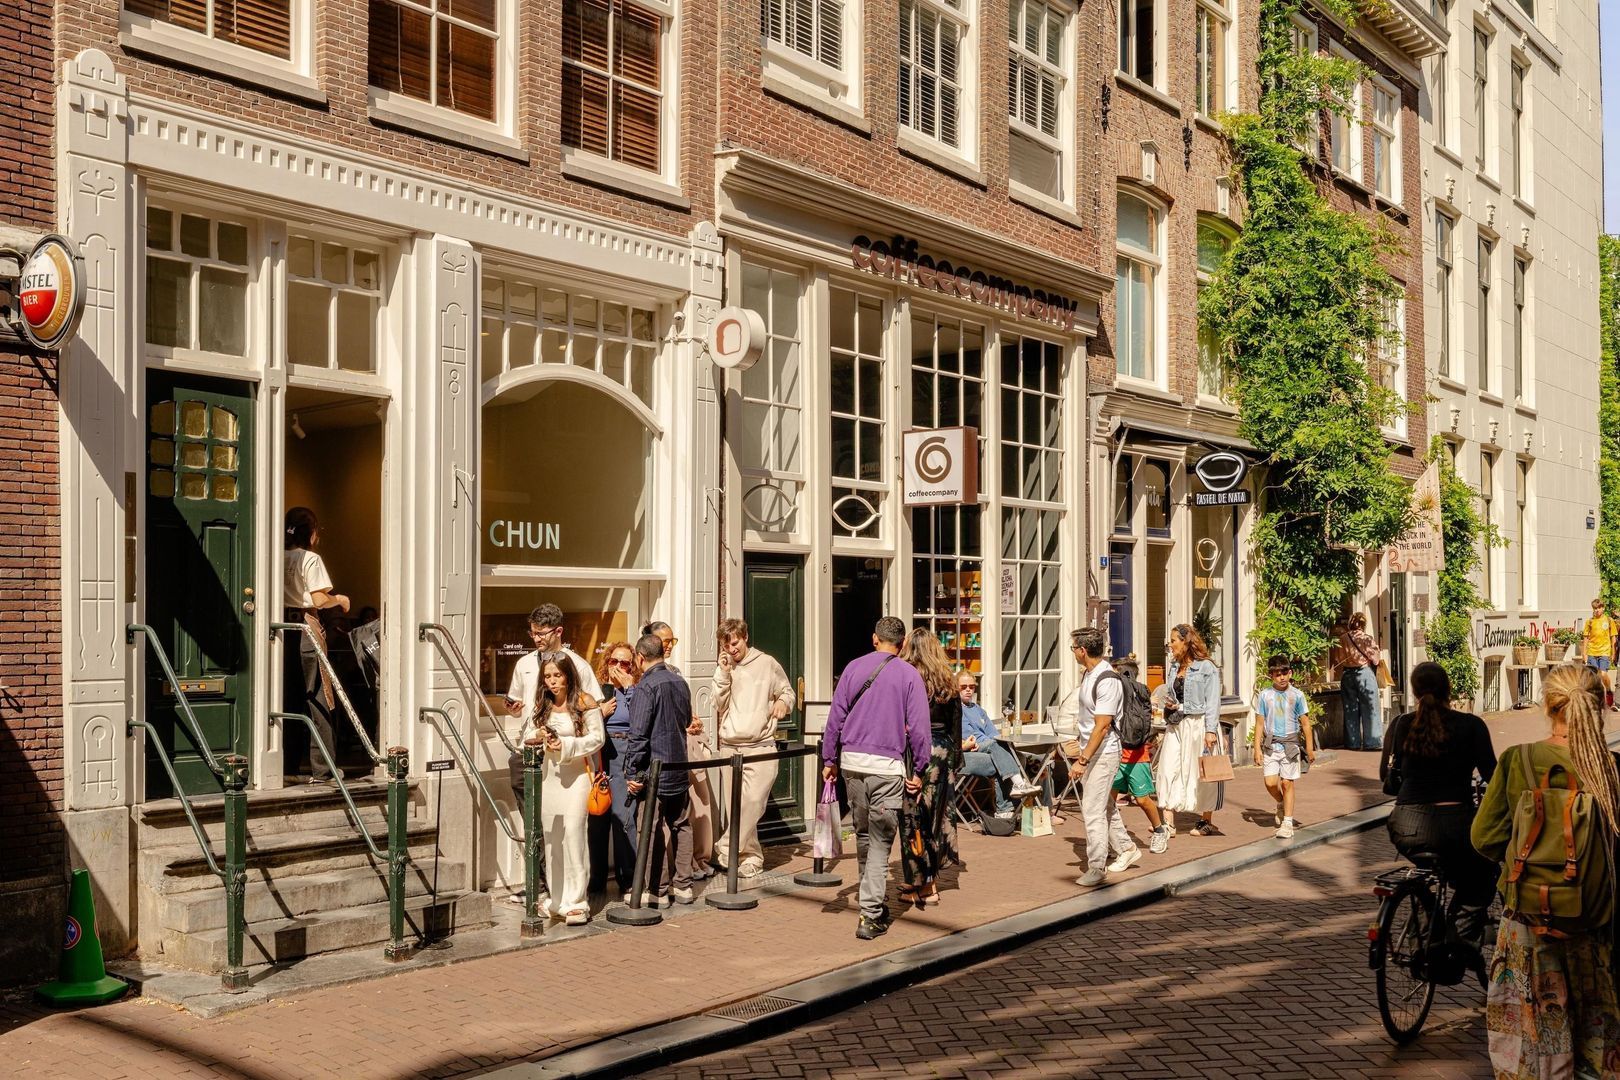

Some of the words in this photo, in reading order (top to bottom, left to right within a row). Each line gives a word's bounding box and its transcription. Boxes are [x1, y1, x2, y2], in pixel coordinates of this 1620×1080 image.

[851, 234, 1078, 331] coffeecompany
[908, 489, 959, 497] coffeecompany
[1196, 493, 1216, 505] PASTEL
[1217, 493, 1227, 503] DE
[1228, 492, 1247, 503] NATA
[489, 519, 560, 550] CHUN
[1405, 532, 1418, 540] UCK
[1412, 542, 1432, 550] WORLD
